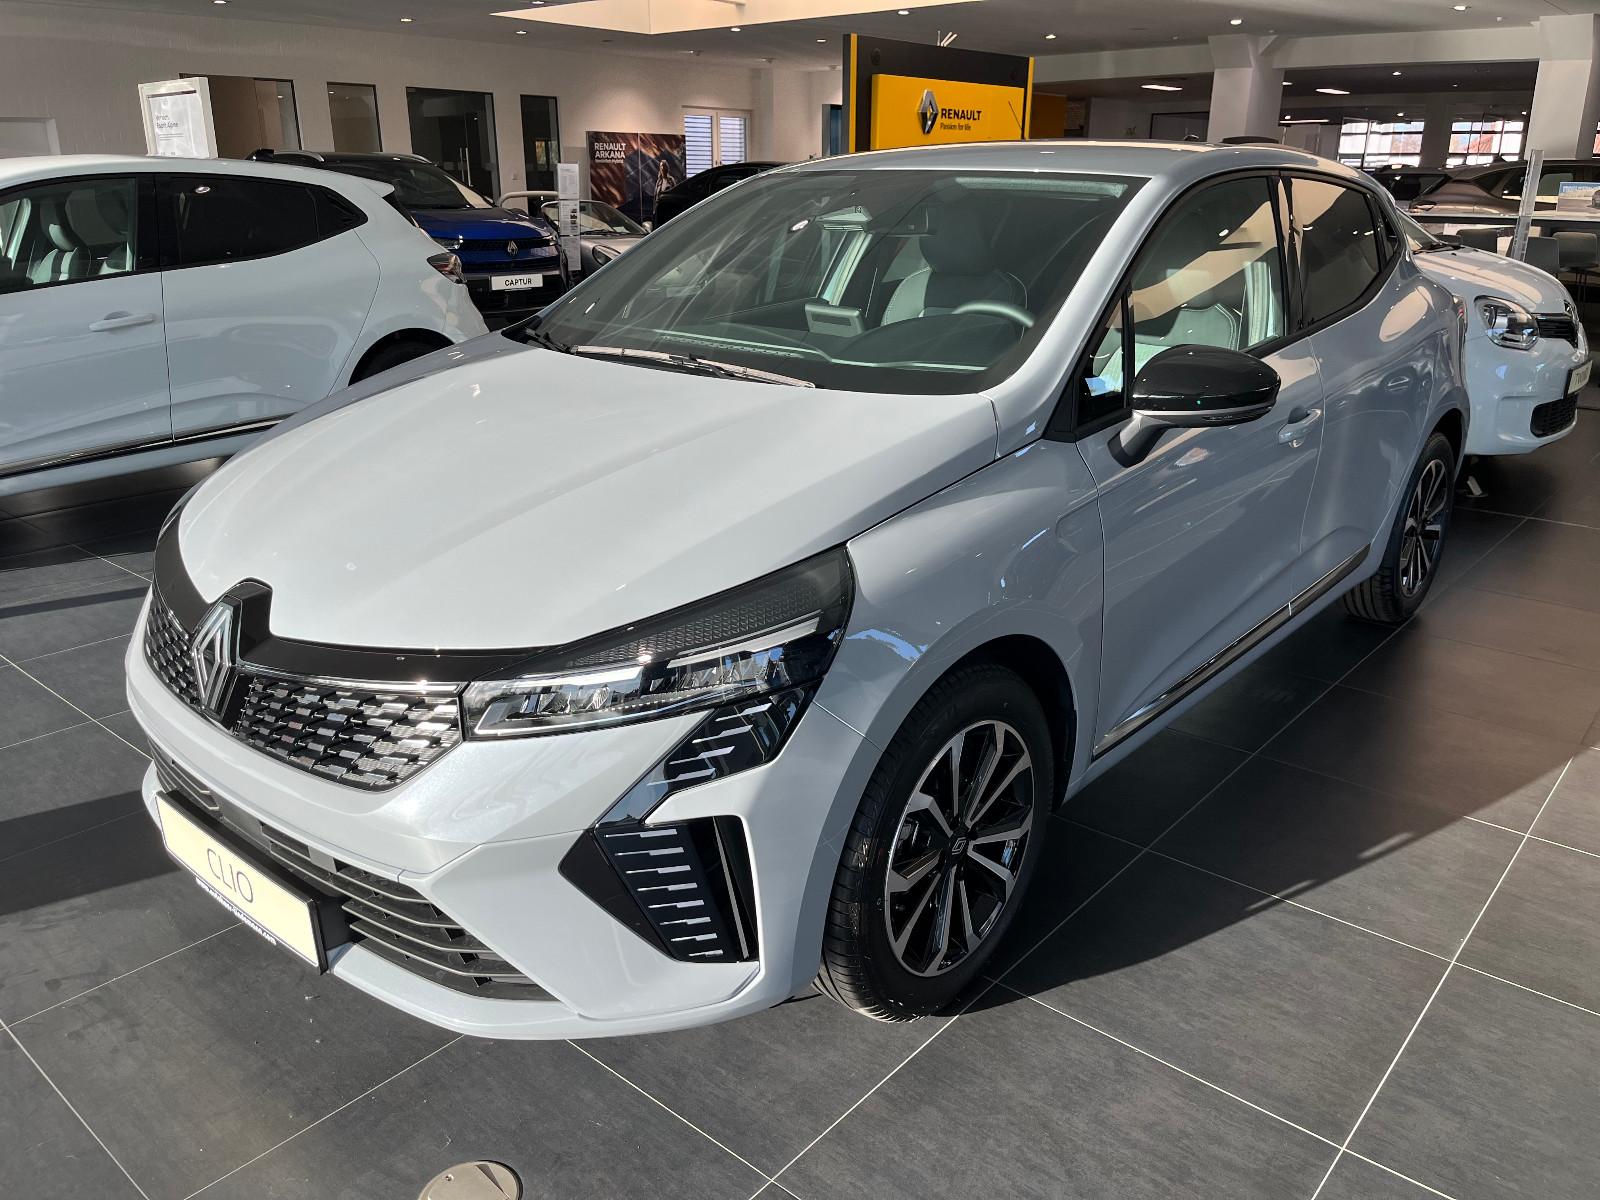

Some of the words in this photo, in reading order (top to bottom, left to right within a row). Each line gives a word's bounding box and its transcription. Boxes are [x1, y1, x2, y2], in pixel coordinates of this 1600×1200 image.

[941, 108, 982, 121] RENAULT
[594, 142, 627, 151] RENAULT
[595, 150, 626, 159] ARKANA
[504, 278, 532, 287] CAPTUR
[207, 848, 254, 904] CLIO
